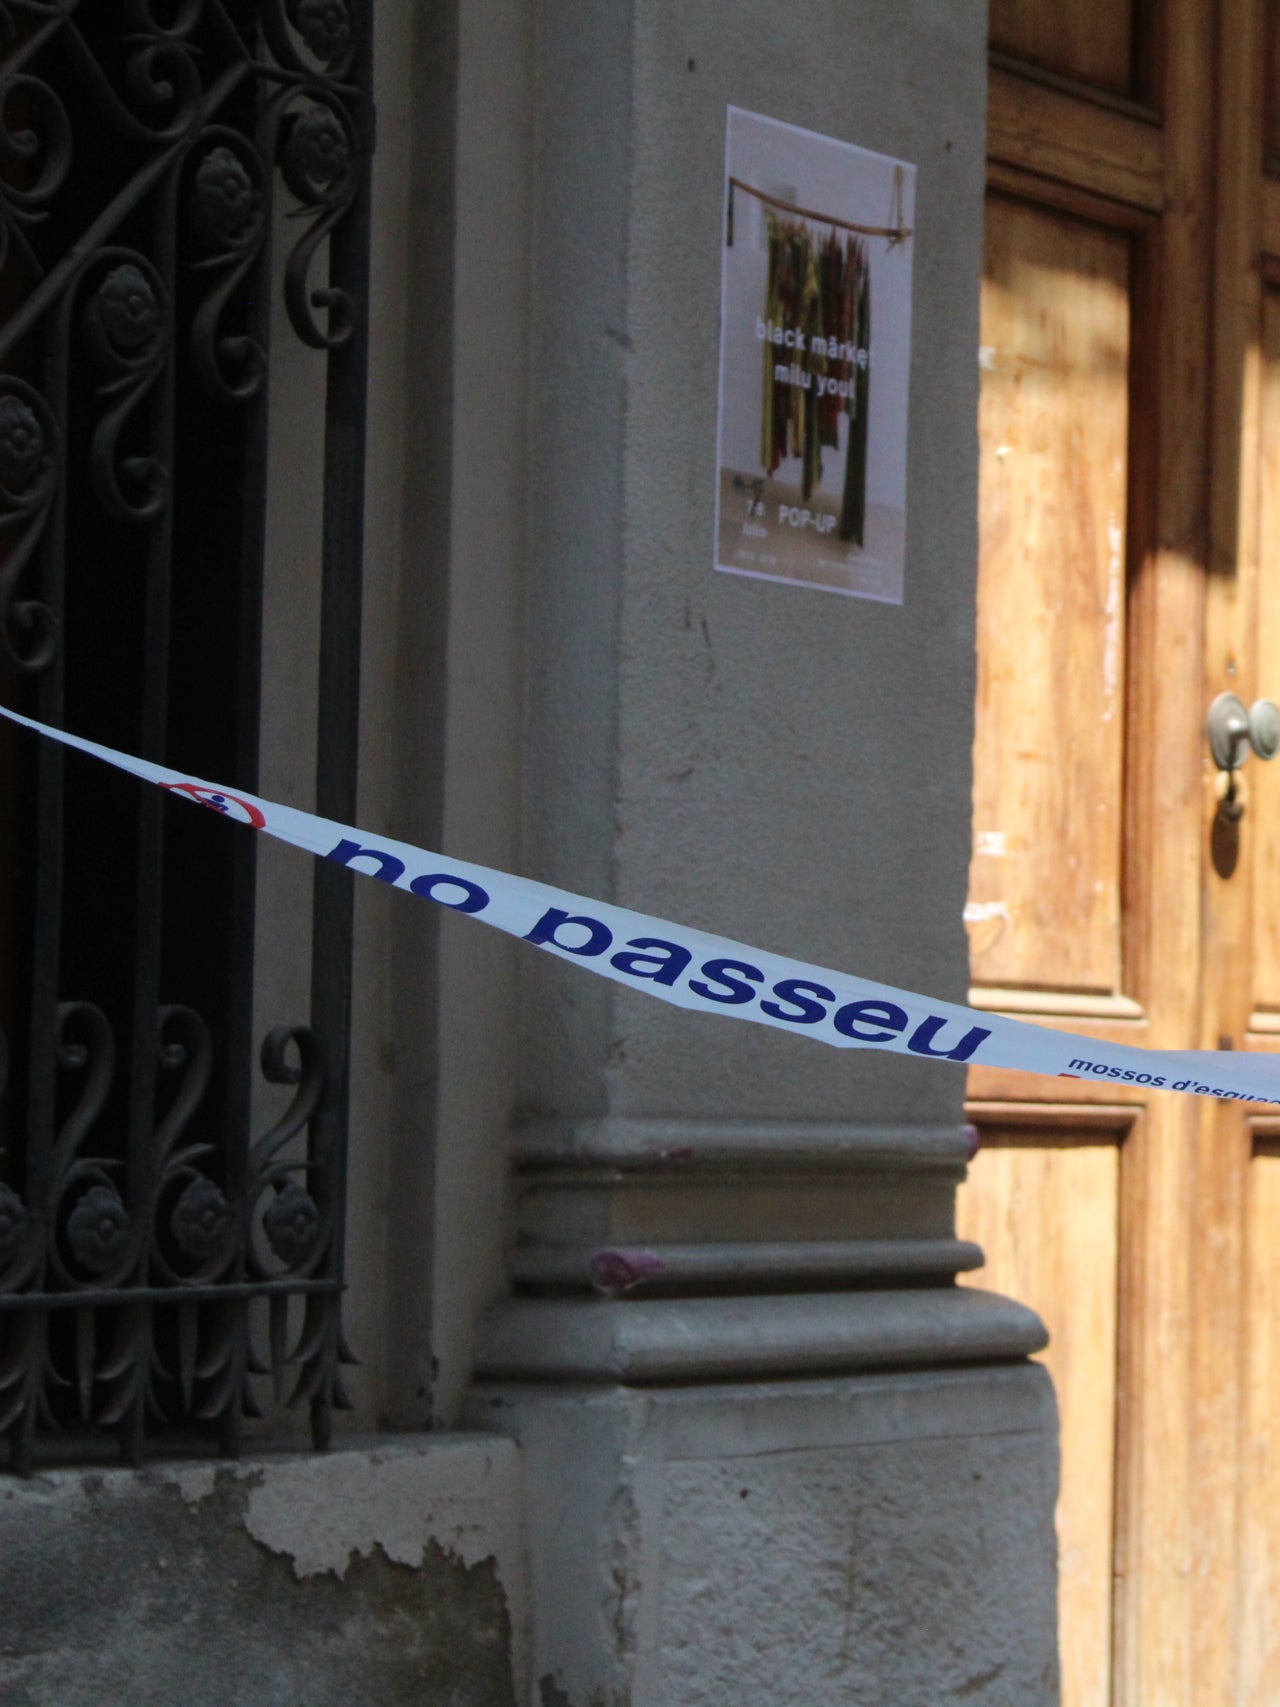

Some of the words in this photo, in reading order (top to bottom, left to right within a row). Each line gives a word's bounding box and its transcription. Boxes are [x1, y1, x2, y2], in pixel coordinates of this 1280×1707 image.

[755, 315, 806, 351] black
[778, 504, 837, 533] POP-UP
[327, 838, 490, 914] no
[525, 907, 992, 1062] passeu
[1068, 1060, 1167, 1087] mossos
